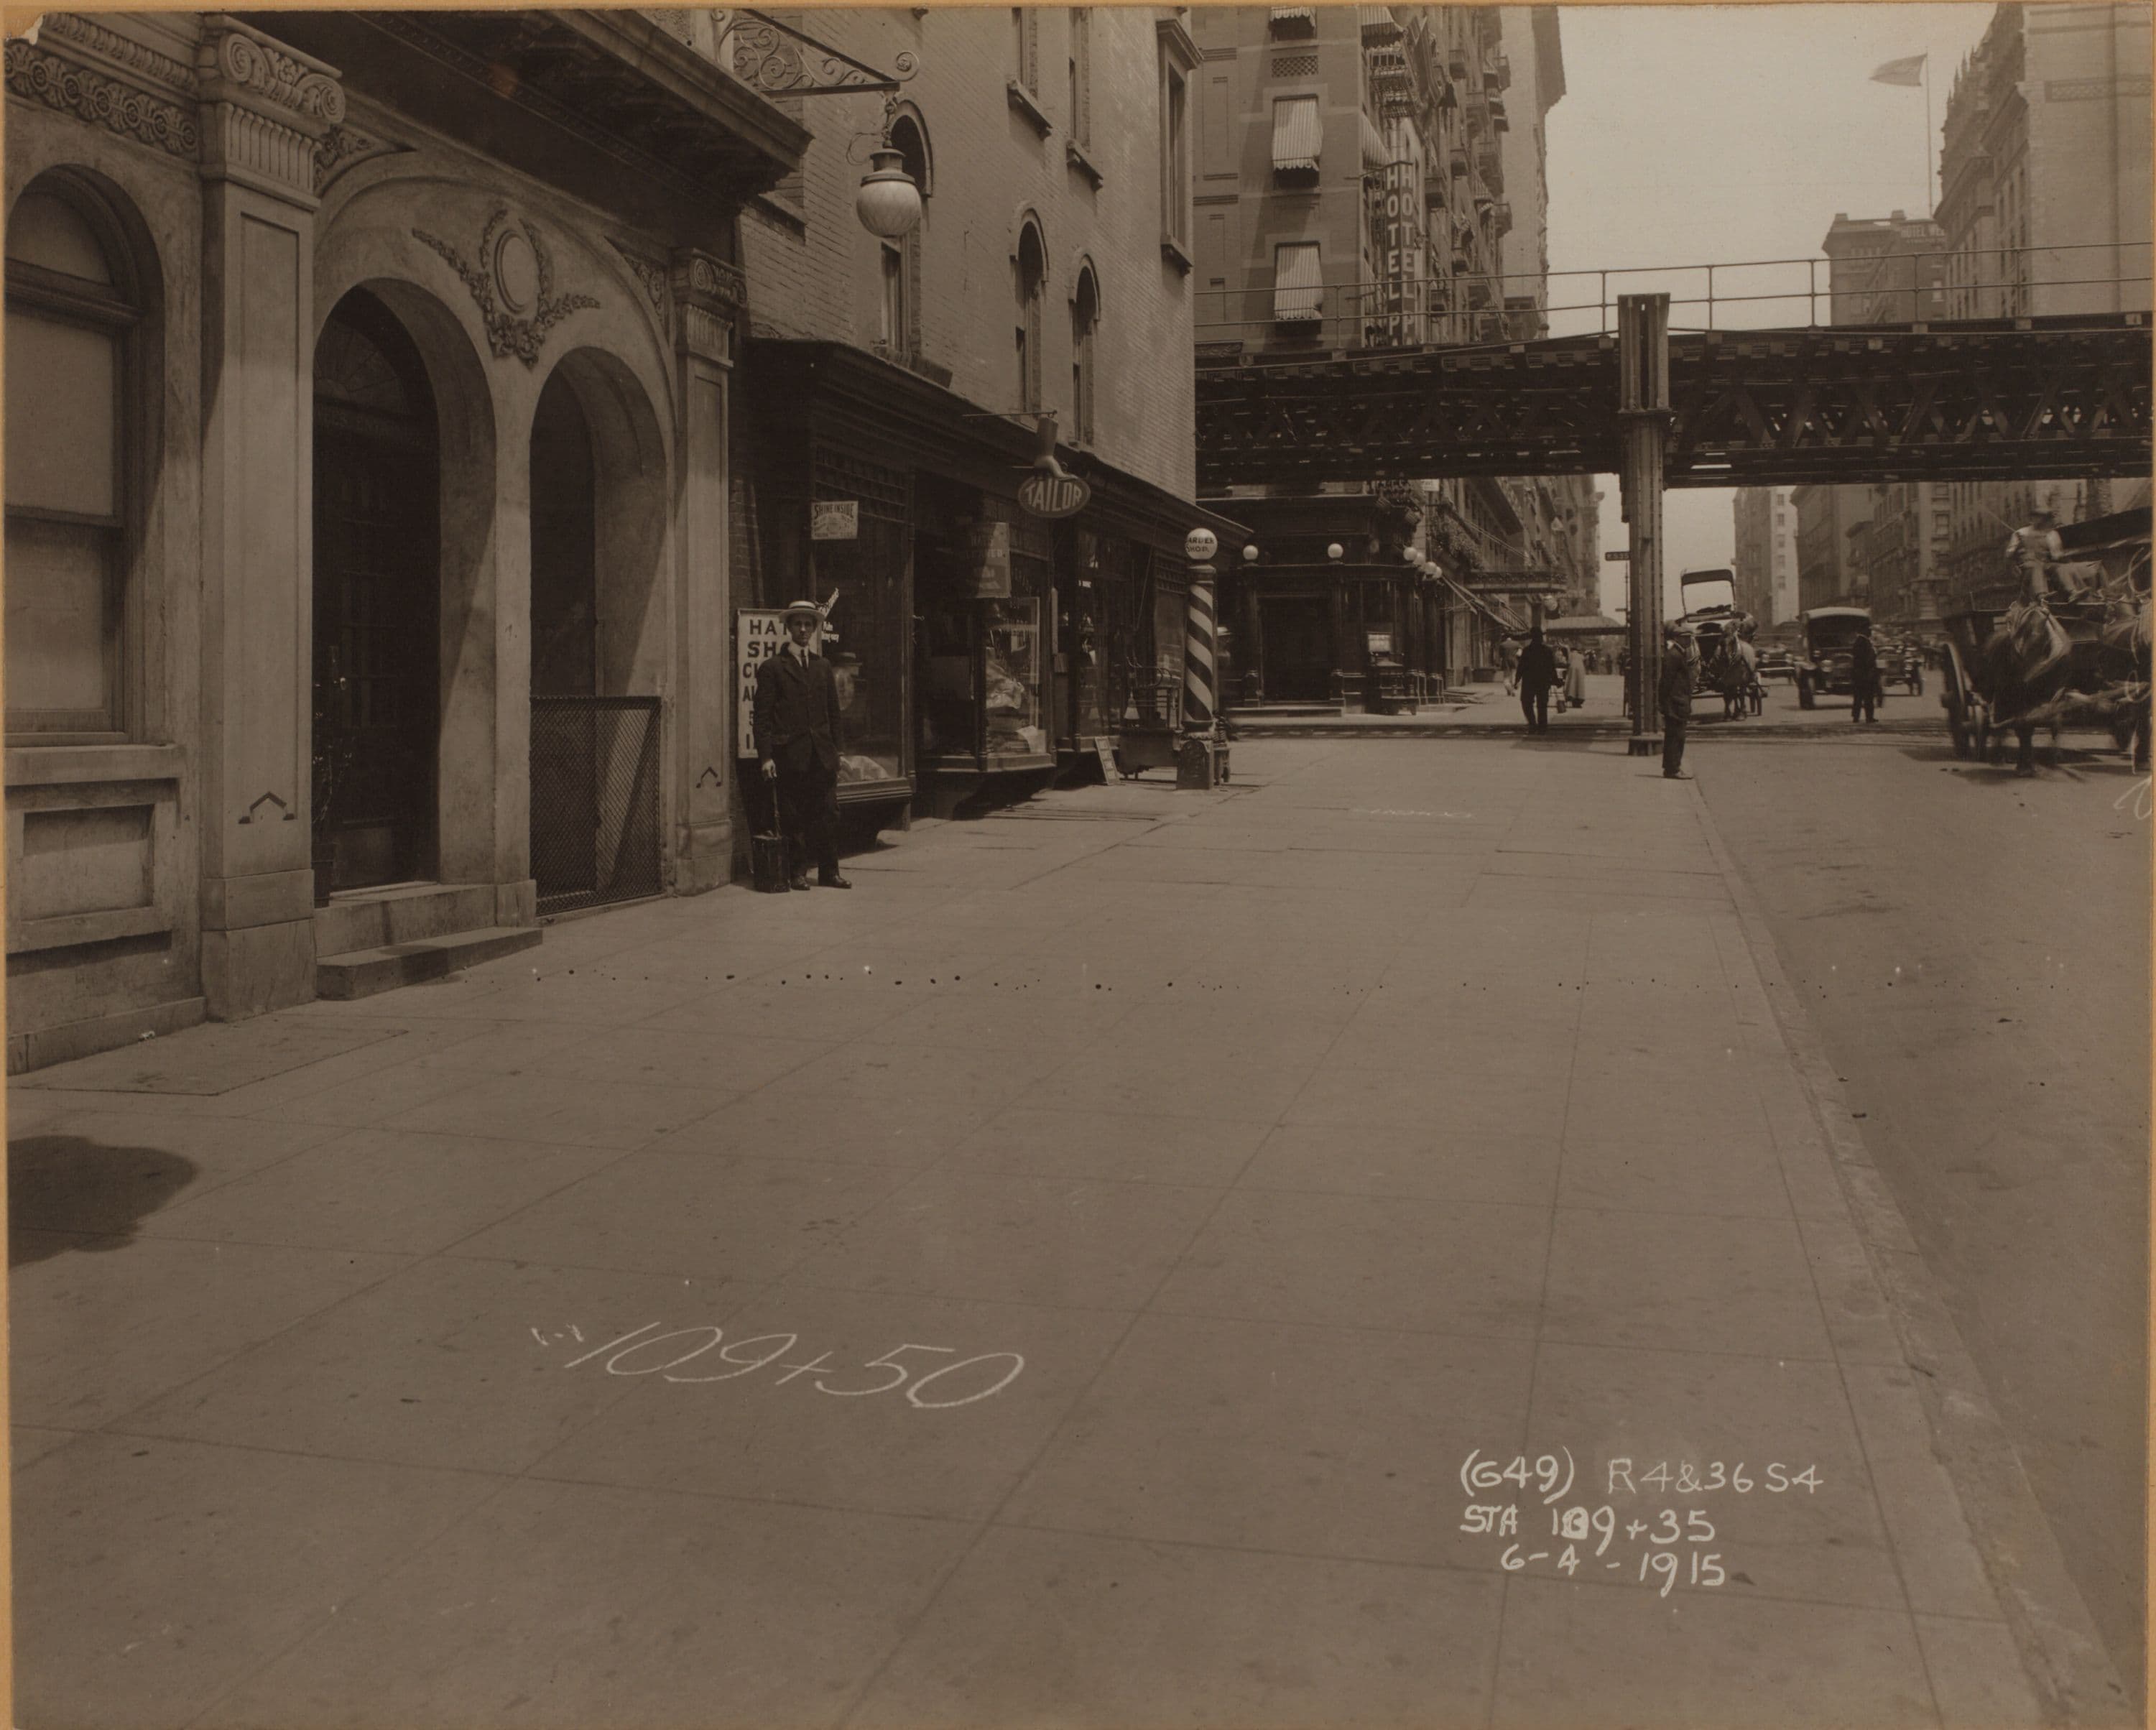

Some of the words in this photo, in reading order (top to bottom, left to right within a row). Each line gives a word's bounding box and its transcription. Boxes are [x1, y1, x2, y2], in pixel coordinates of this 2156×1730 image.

[1387, 165, 1400, 300] HOTEL
[1402, 164, 1415, 299] HOTEL
[1024, 478, 1083, 512] TAILOR
[747, 641, 777, 658] SH
[565, 1321, 1024, 1409] 109+50
